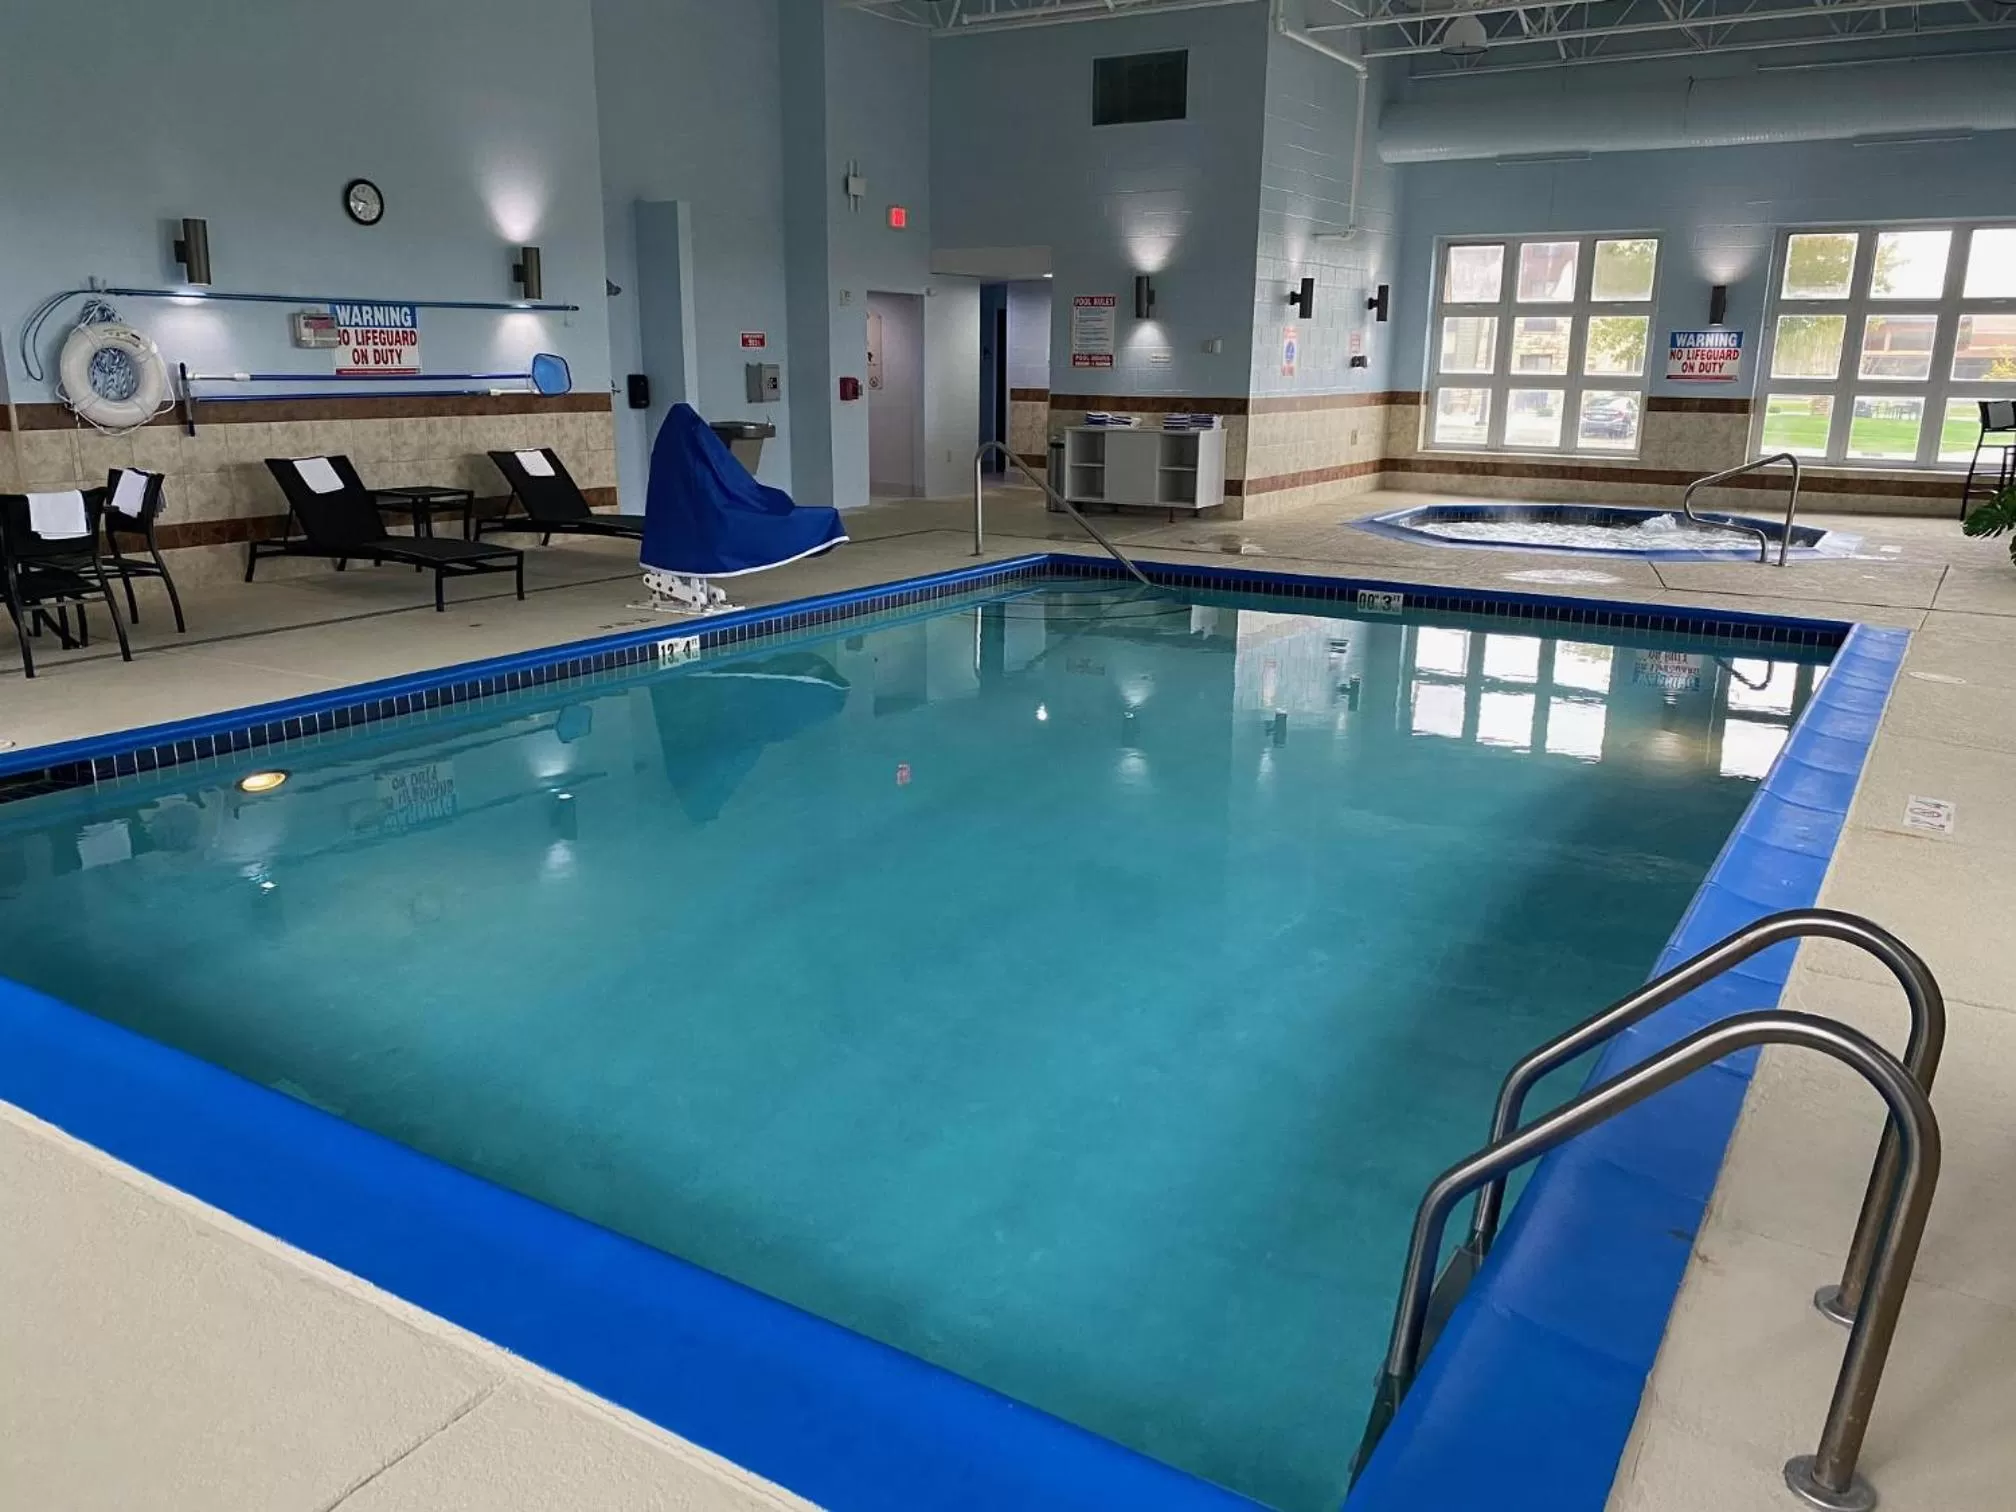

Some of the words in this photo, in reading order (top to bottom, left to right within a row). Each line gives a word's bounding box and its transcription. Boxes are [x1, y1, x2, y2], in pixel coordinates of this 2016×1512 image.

[336, 304, 412, 327] WARNING
[355, 329, 417, 346] LIFEGUARD
[1676, 333, 1738, 348] WARNING
[352, 348, 369, 365] ON
[373, 348, 402, 365] DUTY
[1669, 349, 1684, 361] NO
[1687, 349, 1740, 361] LIFEGUARD
[1681, 361, 1696, 374] ON
[1698, 361, 1724, 374] DUTY
